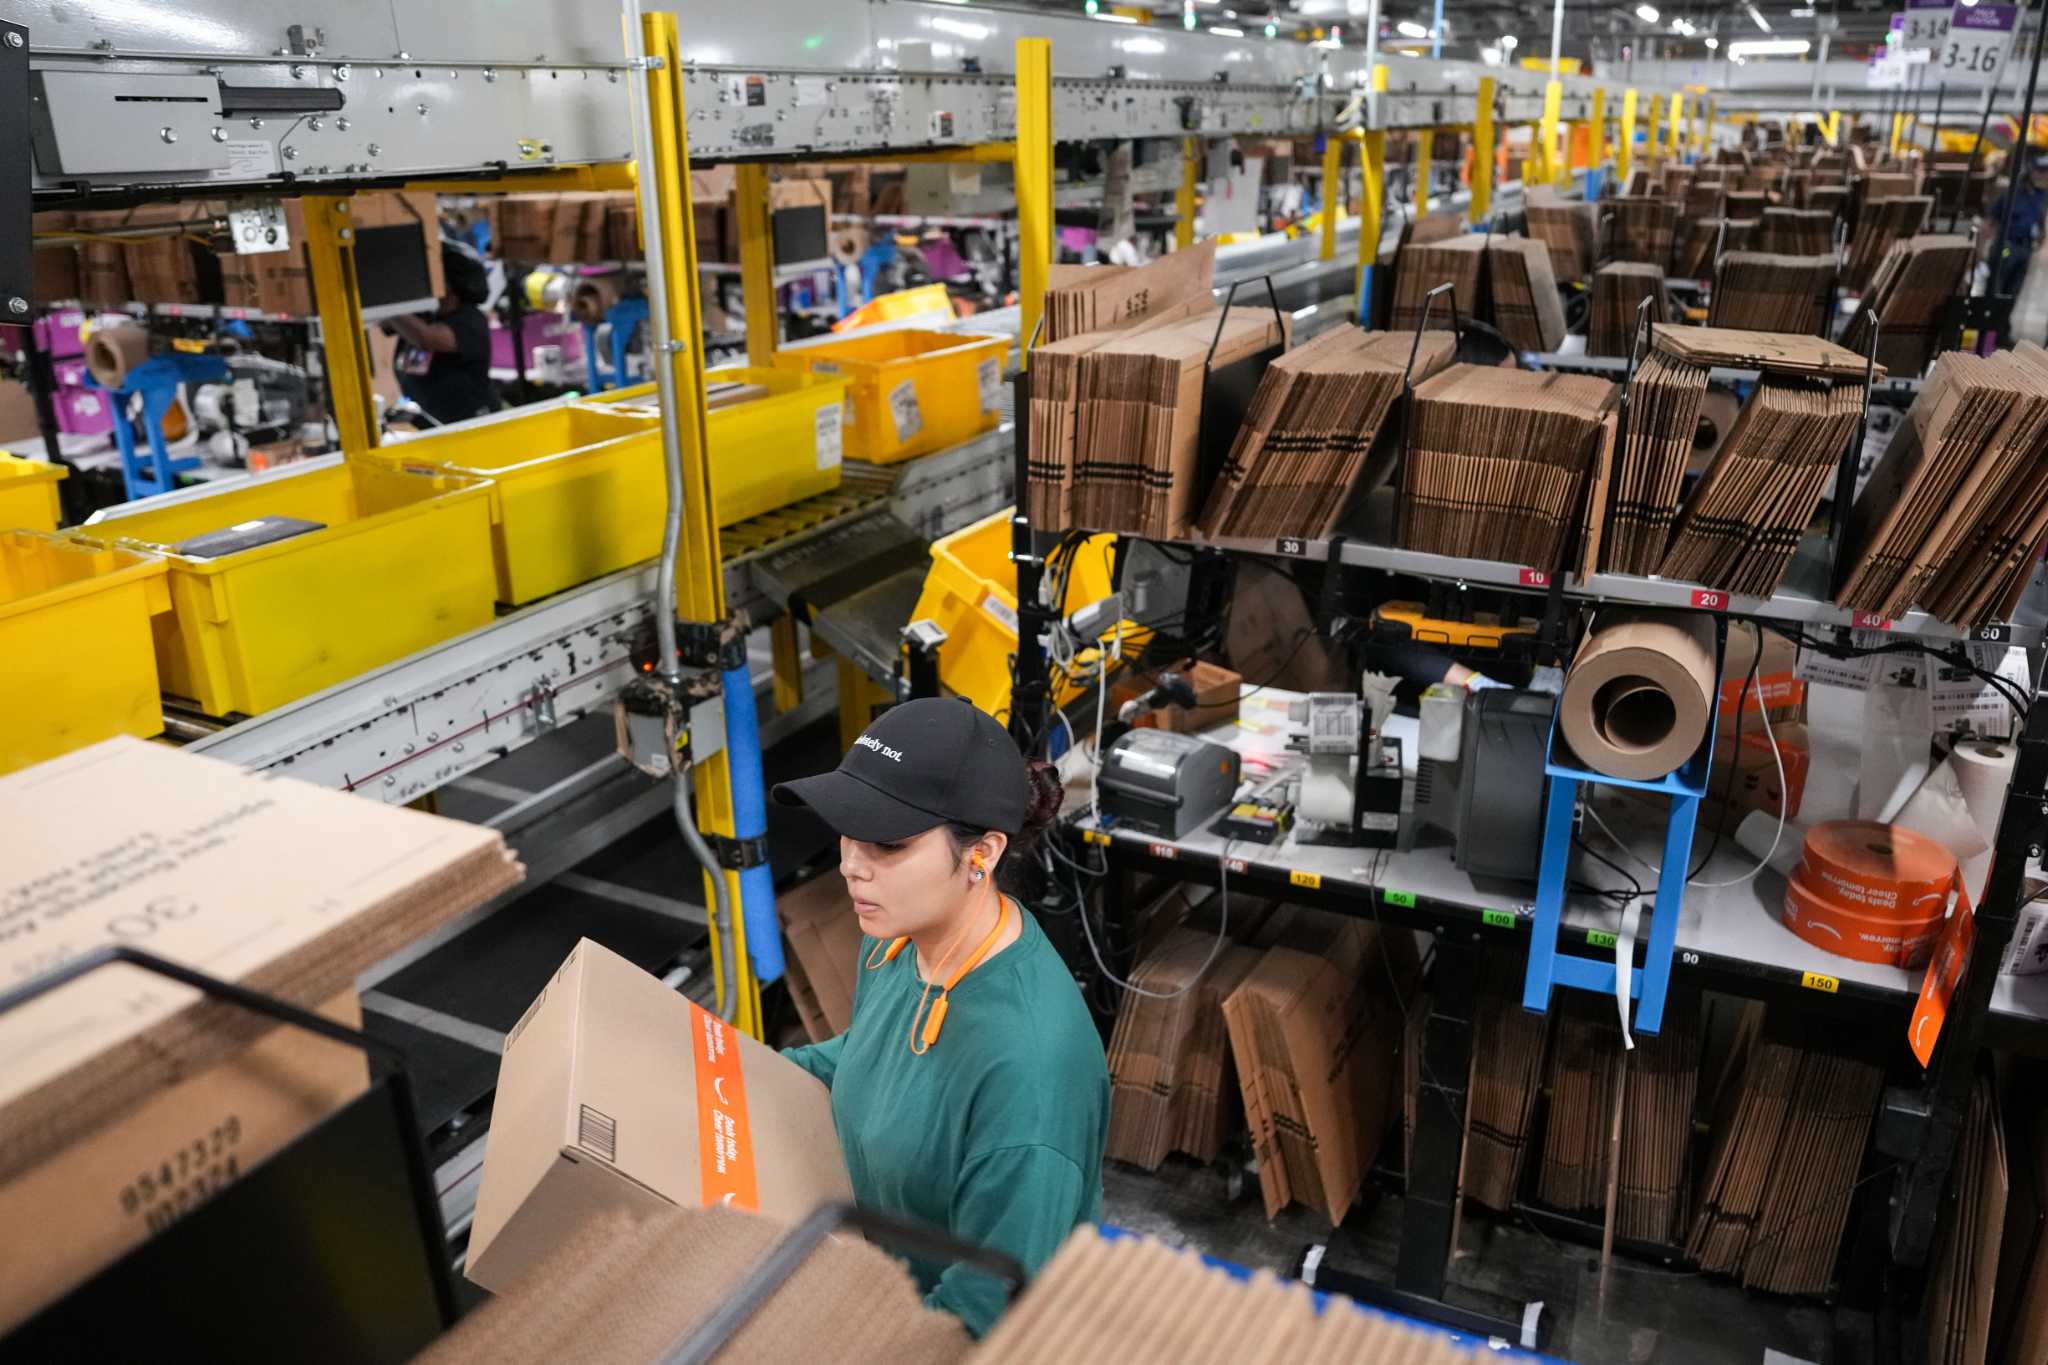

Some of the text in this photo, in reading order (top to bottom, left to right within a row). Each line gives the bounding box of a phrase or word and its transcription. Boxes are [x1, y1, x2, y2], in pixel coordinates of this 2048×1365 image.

[1909, 18, 1949, 40] 3-14
[1943, 43, 1999, 73] 3-16
[1284, 541, 1299, 553] 30
[1528, 572, 1544, 583] 10
[1700, 593, 1718, 606] 20
[1862, 614, 1881, 627] 40
[1980, 628, 2000, 640] 60
[1155, 845, 1173, 858] 110
[1295, 874, 1316, 886] 120
[1488, 912, 1510, 926] 100
[1593, 932, 1614, 946] 130
[1682, 952, 1699, 965] 90
[1809, 976, 1833, 990] 150
